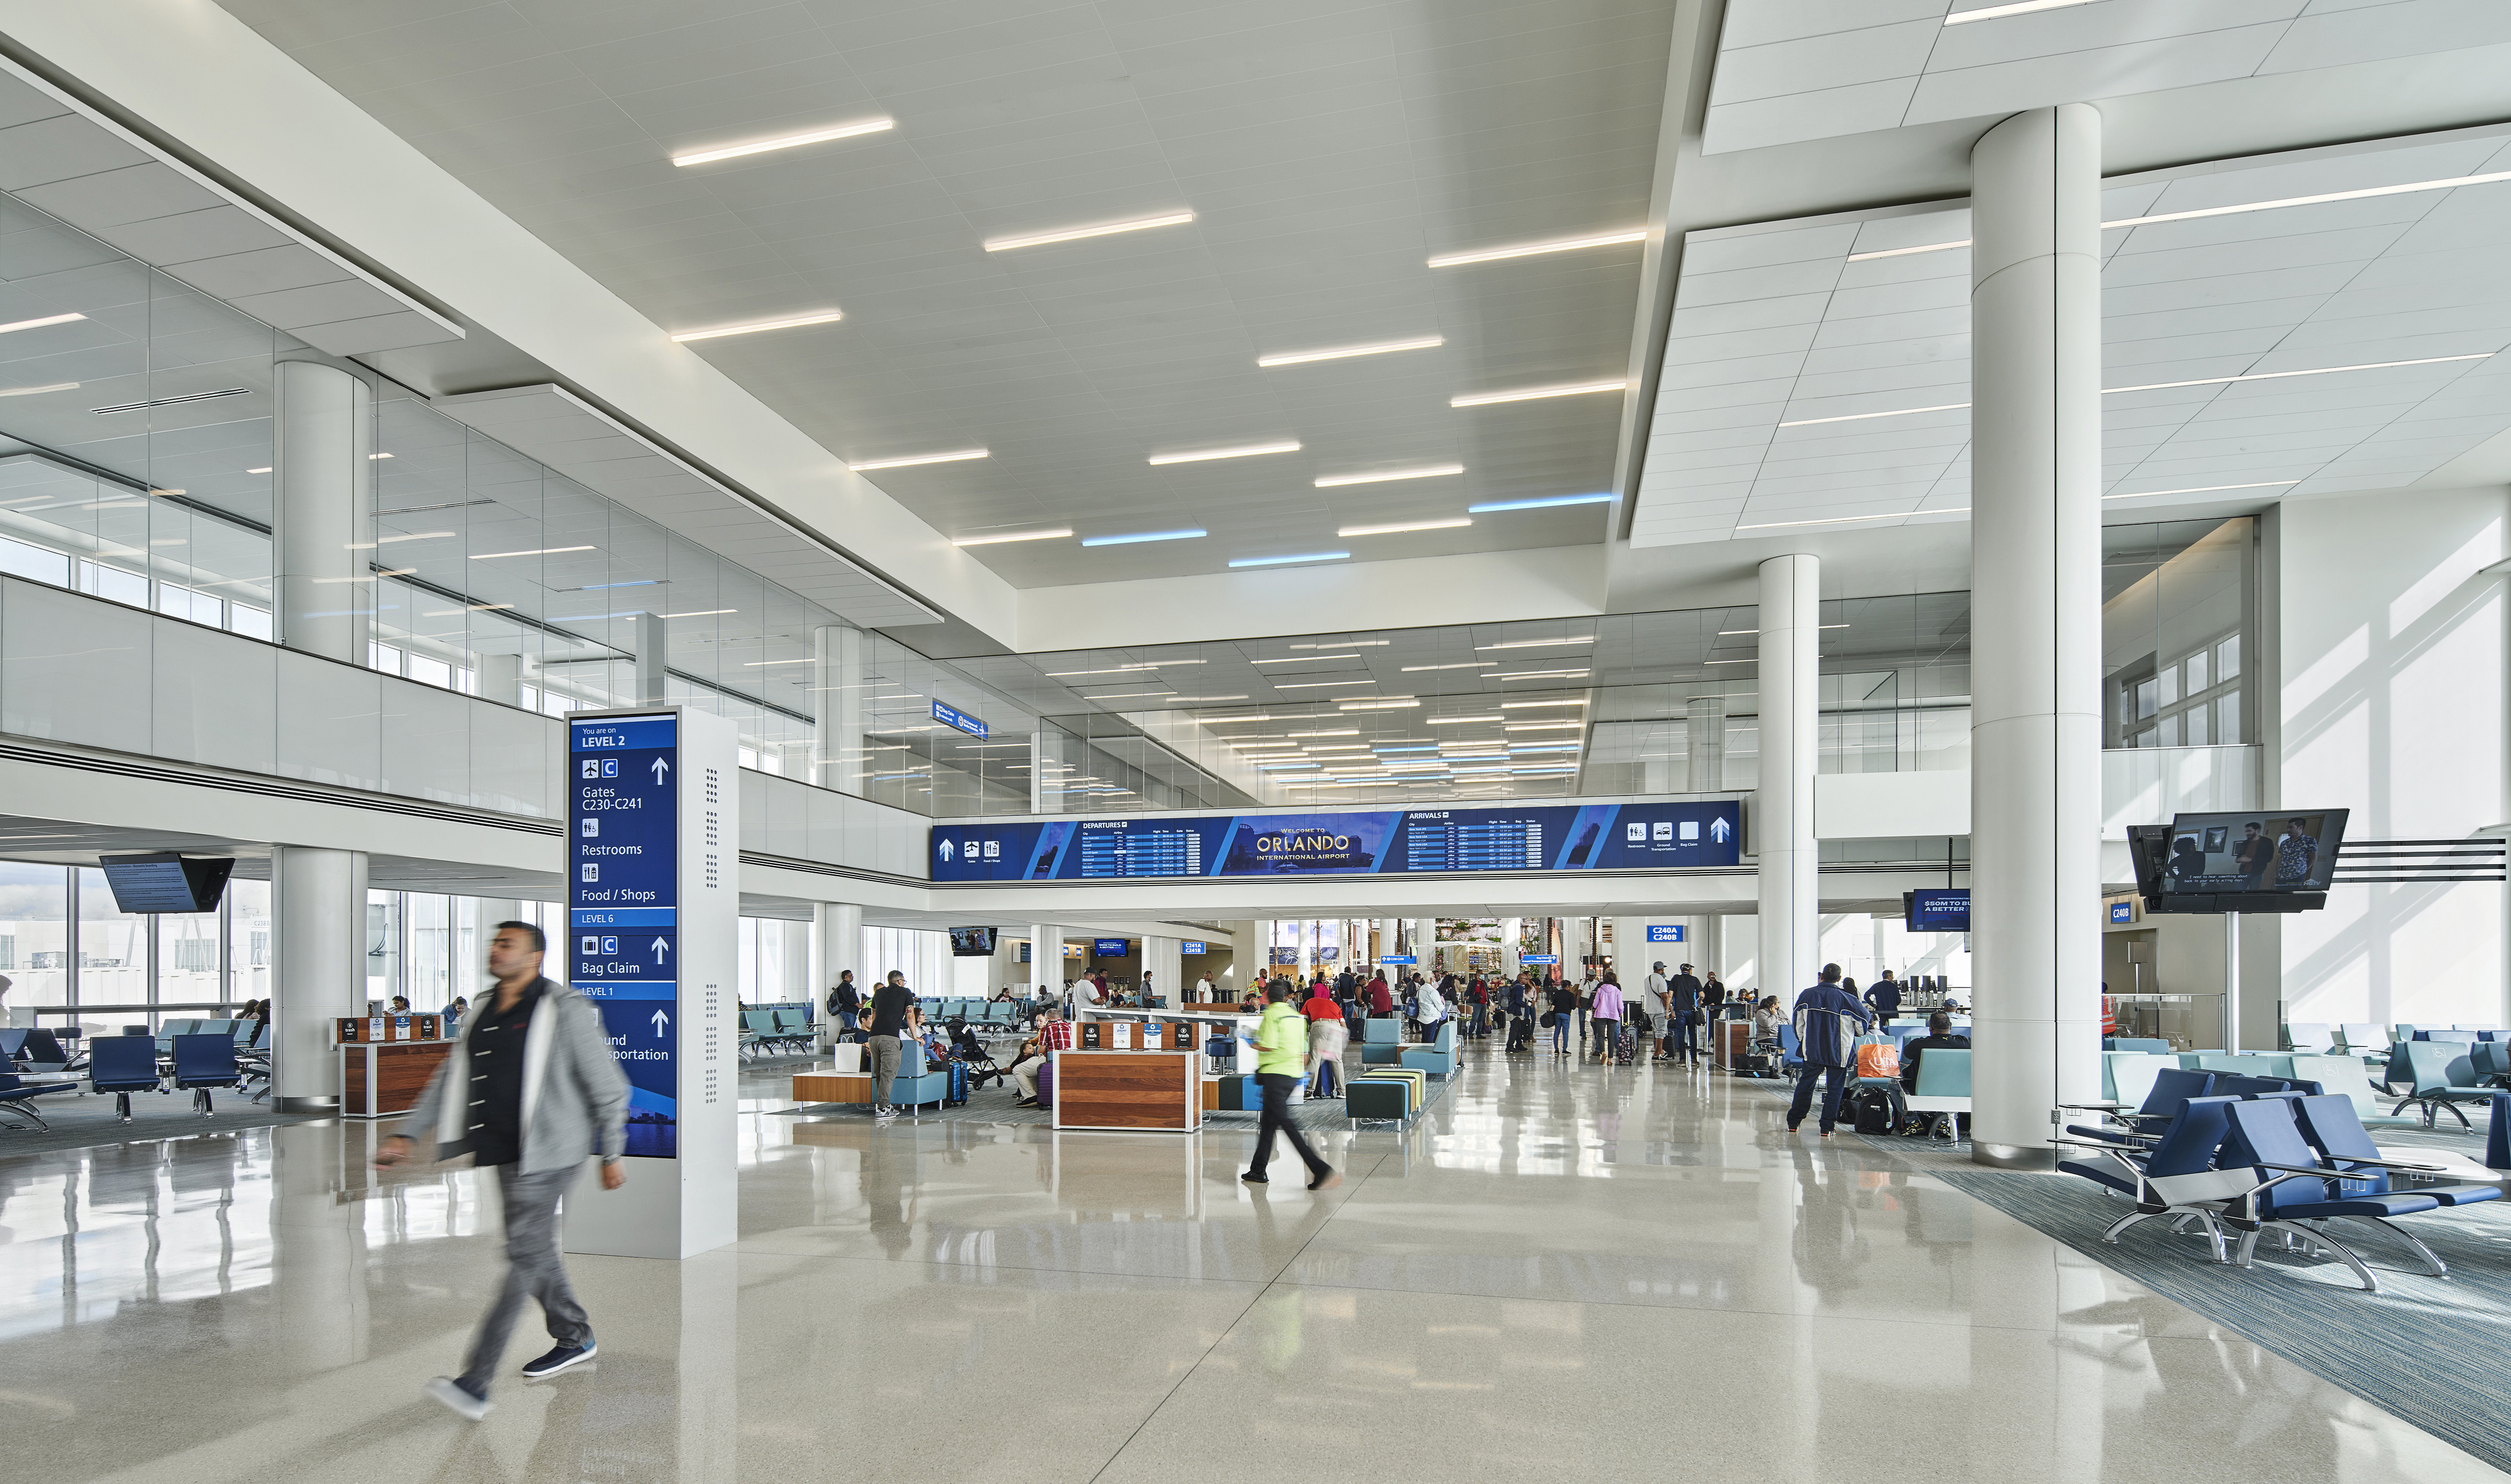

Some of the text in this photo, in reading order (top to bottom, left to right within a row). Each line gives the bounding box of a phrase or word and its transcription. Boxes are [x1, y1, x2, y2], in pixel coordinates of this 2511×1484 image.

[582, 736, 625, 748] LEVEL 2
[605, 763, 614, 774] C
[583, 787, 615, 797] Gates
[582, 798, 642, 810] C230-C241
[1257, 835, 1349, 852] ORLANDO
[582, 845, 642, 855] Restrooms
[582, 889, 655, 902] Food / Shops
[2113, 908, 2128, 918] C240B
[605, 940, 614, 951] C
[582, 963, 639, 975] Bag Claim
[599, 1034, 626, 1045] und
[608, 1049, 668, 1061] sportation
[1874, 1057, 1896, 1066] ULTA
